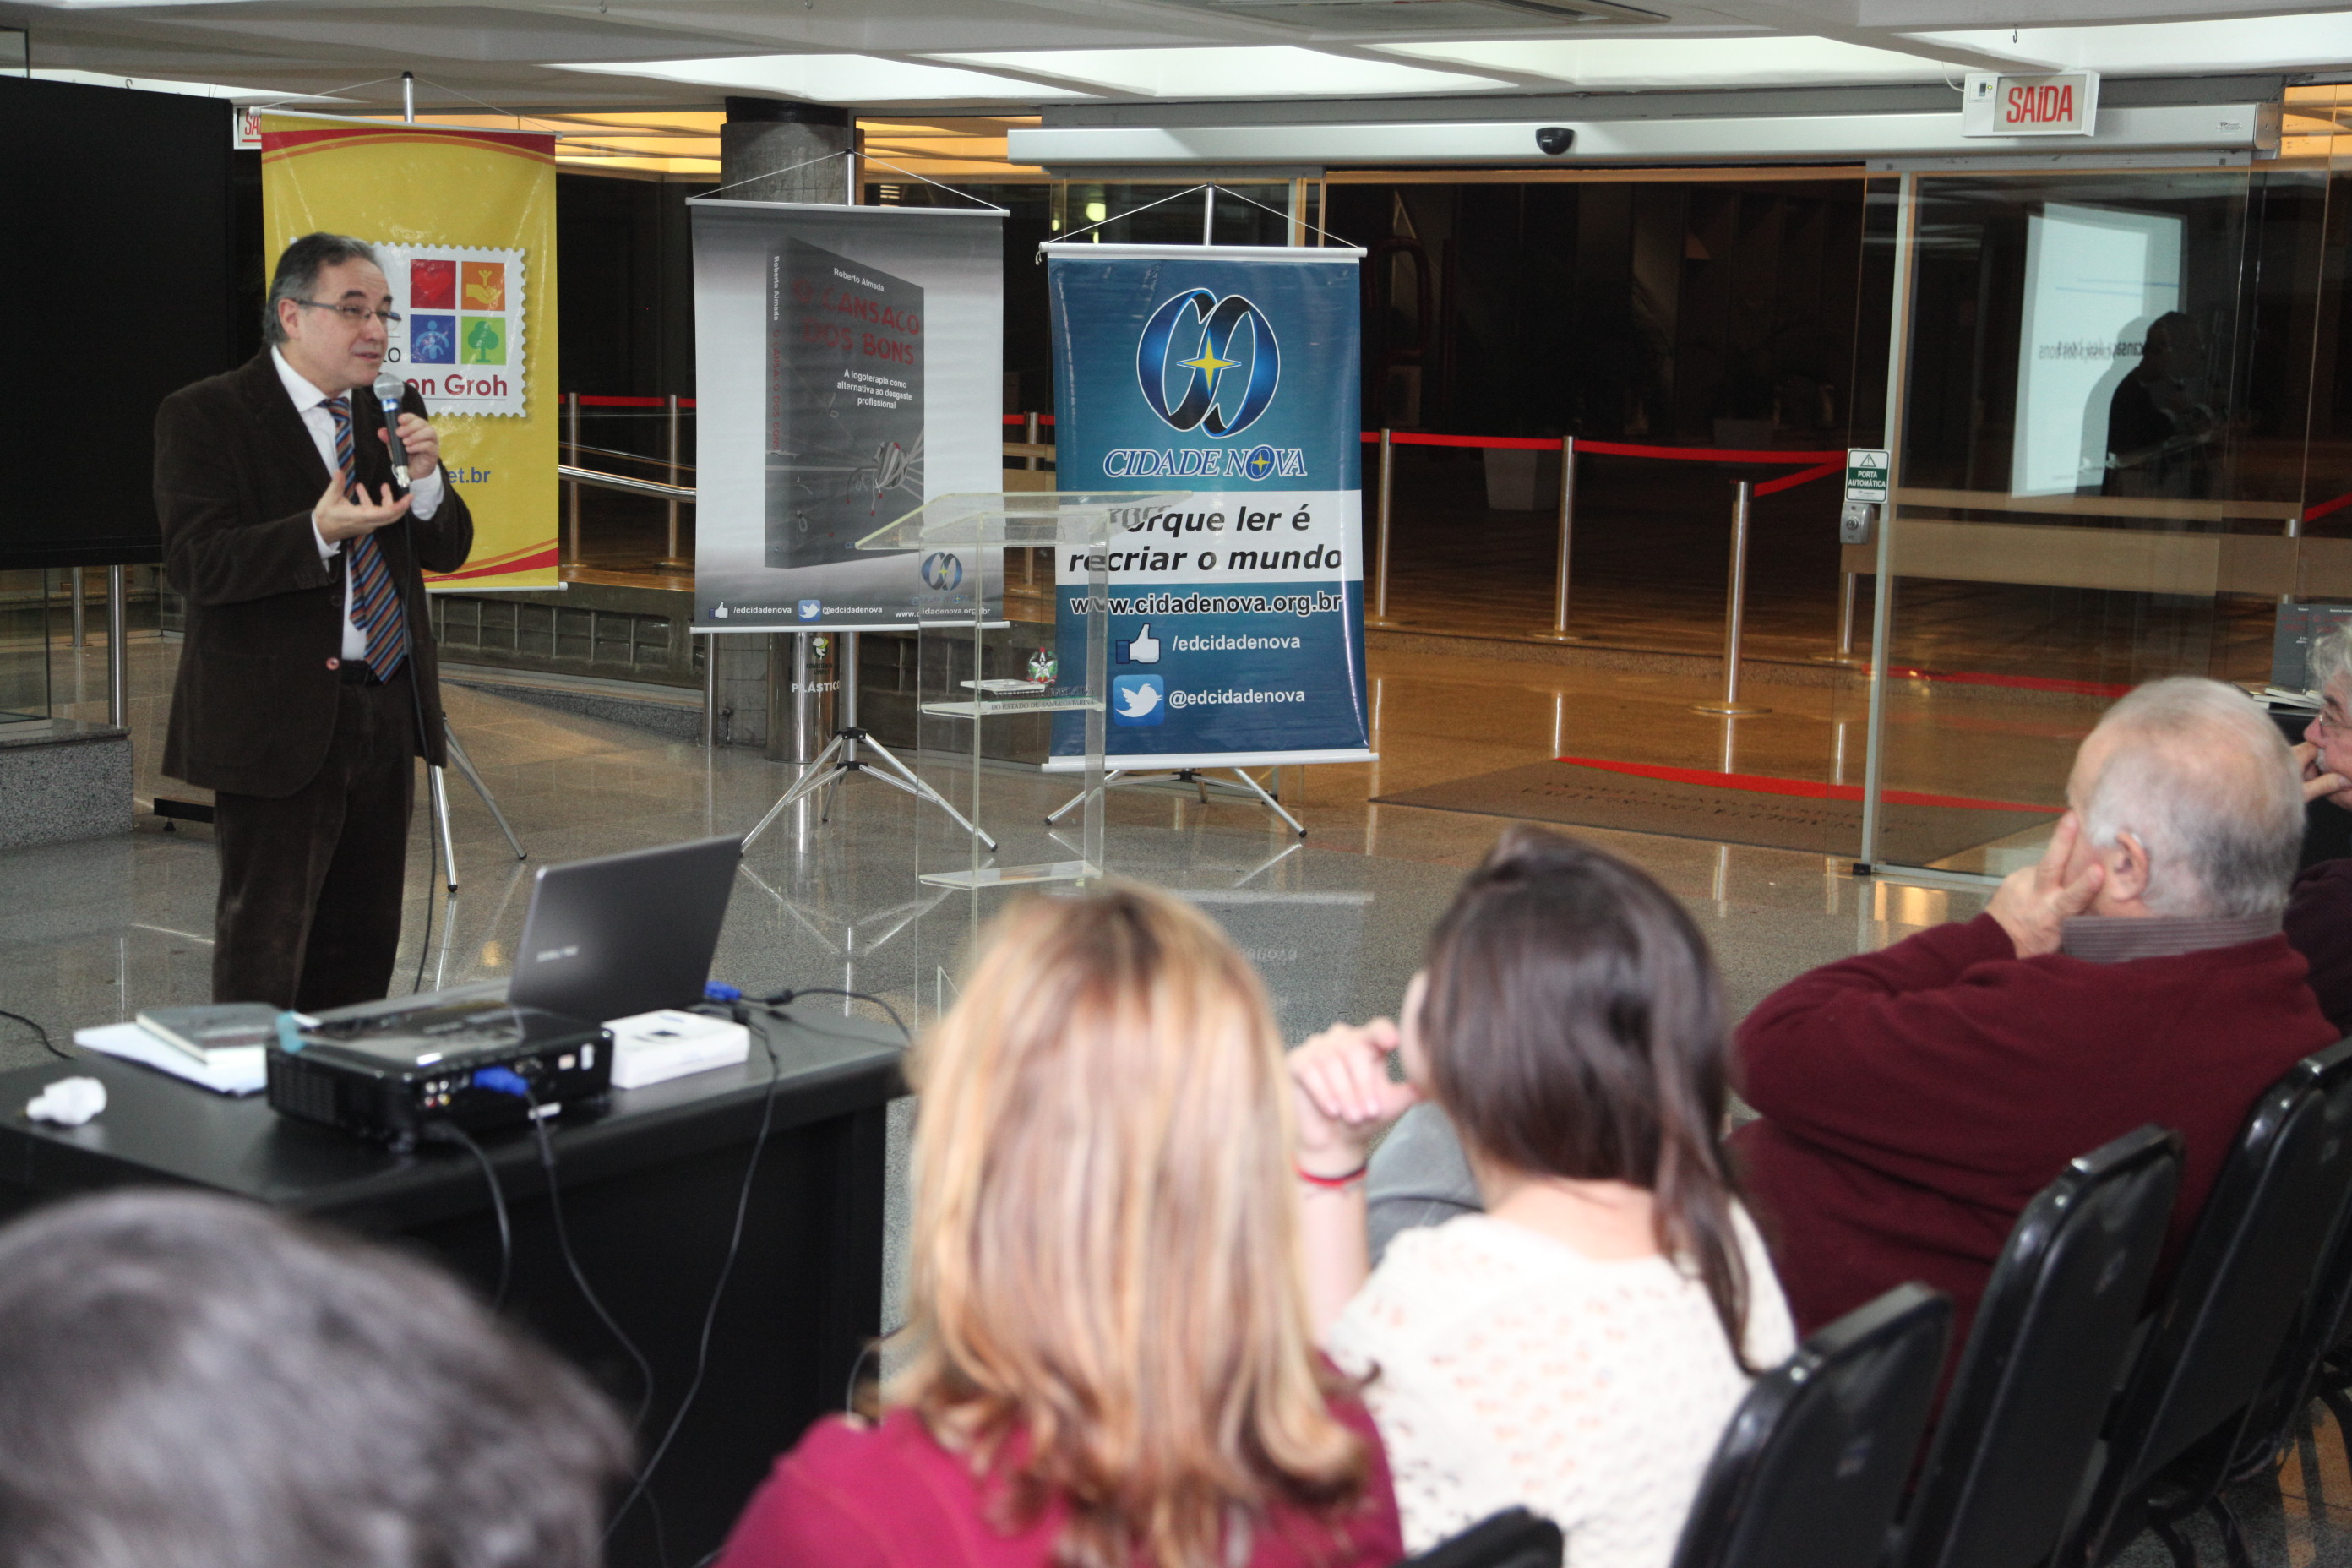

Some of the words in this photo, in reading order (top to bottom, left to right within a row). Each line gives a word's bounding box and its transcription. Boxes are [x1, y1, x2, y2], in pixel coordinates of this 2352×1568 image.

[833, 267, 861, 284] Roberto
[861, 278, 885, 292] Almada
[862, 332, 915, 366] BONS
[444, 373, 508, 397] Groh
[844, 369, 850, 378] A
[851, 370, 889, 386] logoterapia
[890, 379, 907, 389] como
[836, 380, 874, 395] alternativa
[885, 389, 912, 400] desgaste
[857, 397, 896, 409] profissional
[1102, 449, 1222, 478] CIDADE
[1224, 444, 1308, 482] NOVA
[1848, 478, 1886, 488] AUTOMÁTICA
[1857, 470, 1878, 479] PORTA
[1236, 506, 1282, 531] ler
[1291, 504, 1311, 531] é
[1068, 546, 1188, 572] recriar
[1197, 551, 1217, 571] o
[1228, 543, 1343, 570] mundo
[732, 606, 792, 614] /edcidadenova
[822, 606, 883, 615] @edcidadenova
[1070, 591, 1343, 617] www.cidadenova.org.br
[1171, 635, 1302, 651] /edcidadenova
[1168, 689, 1306, 709] @edcidadenova
